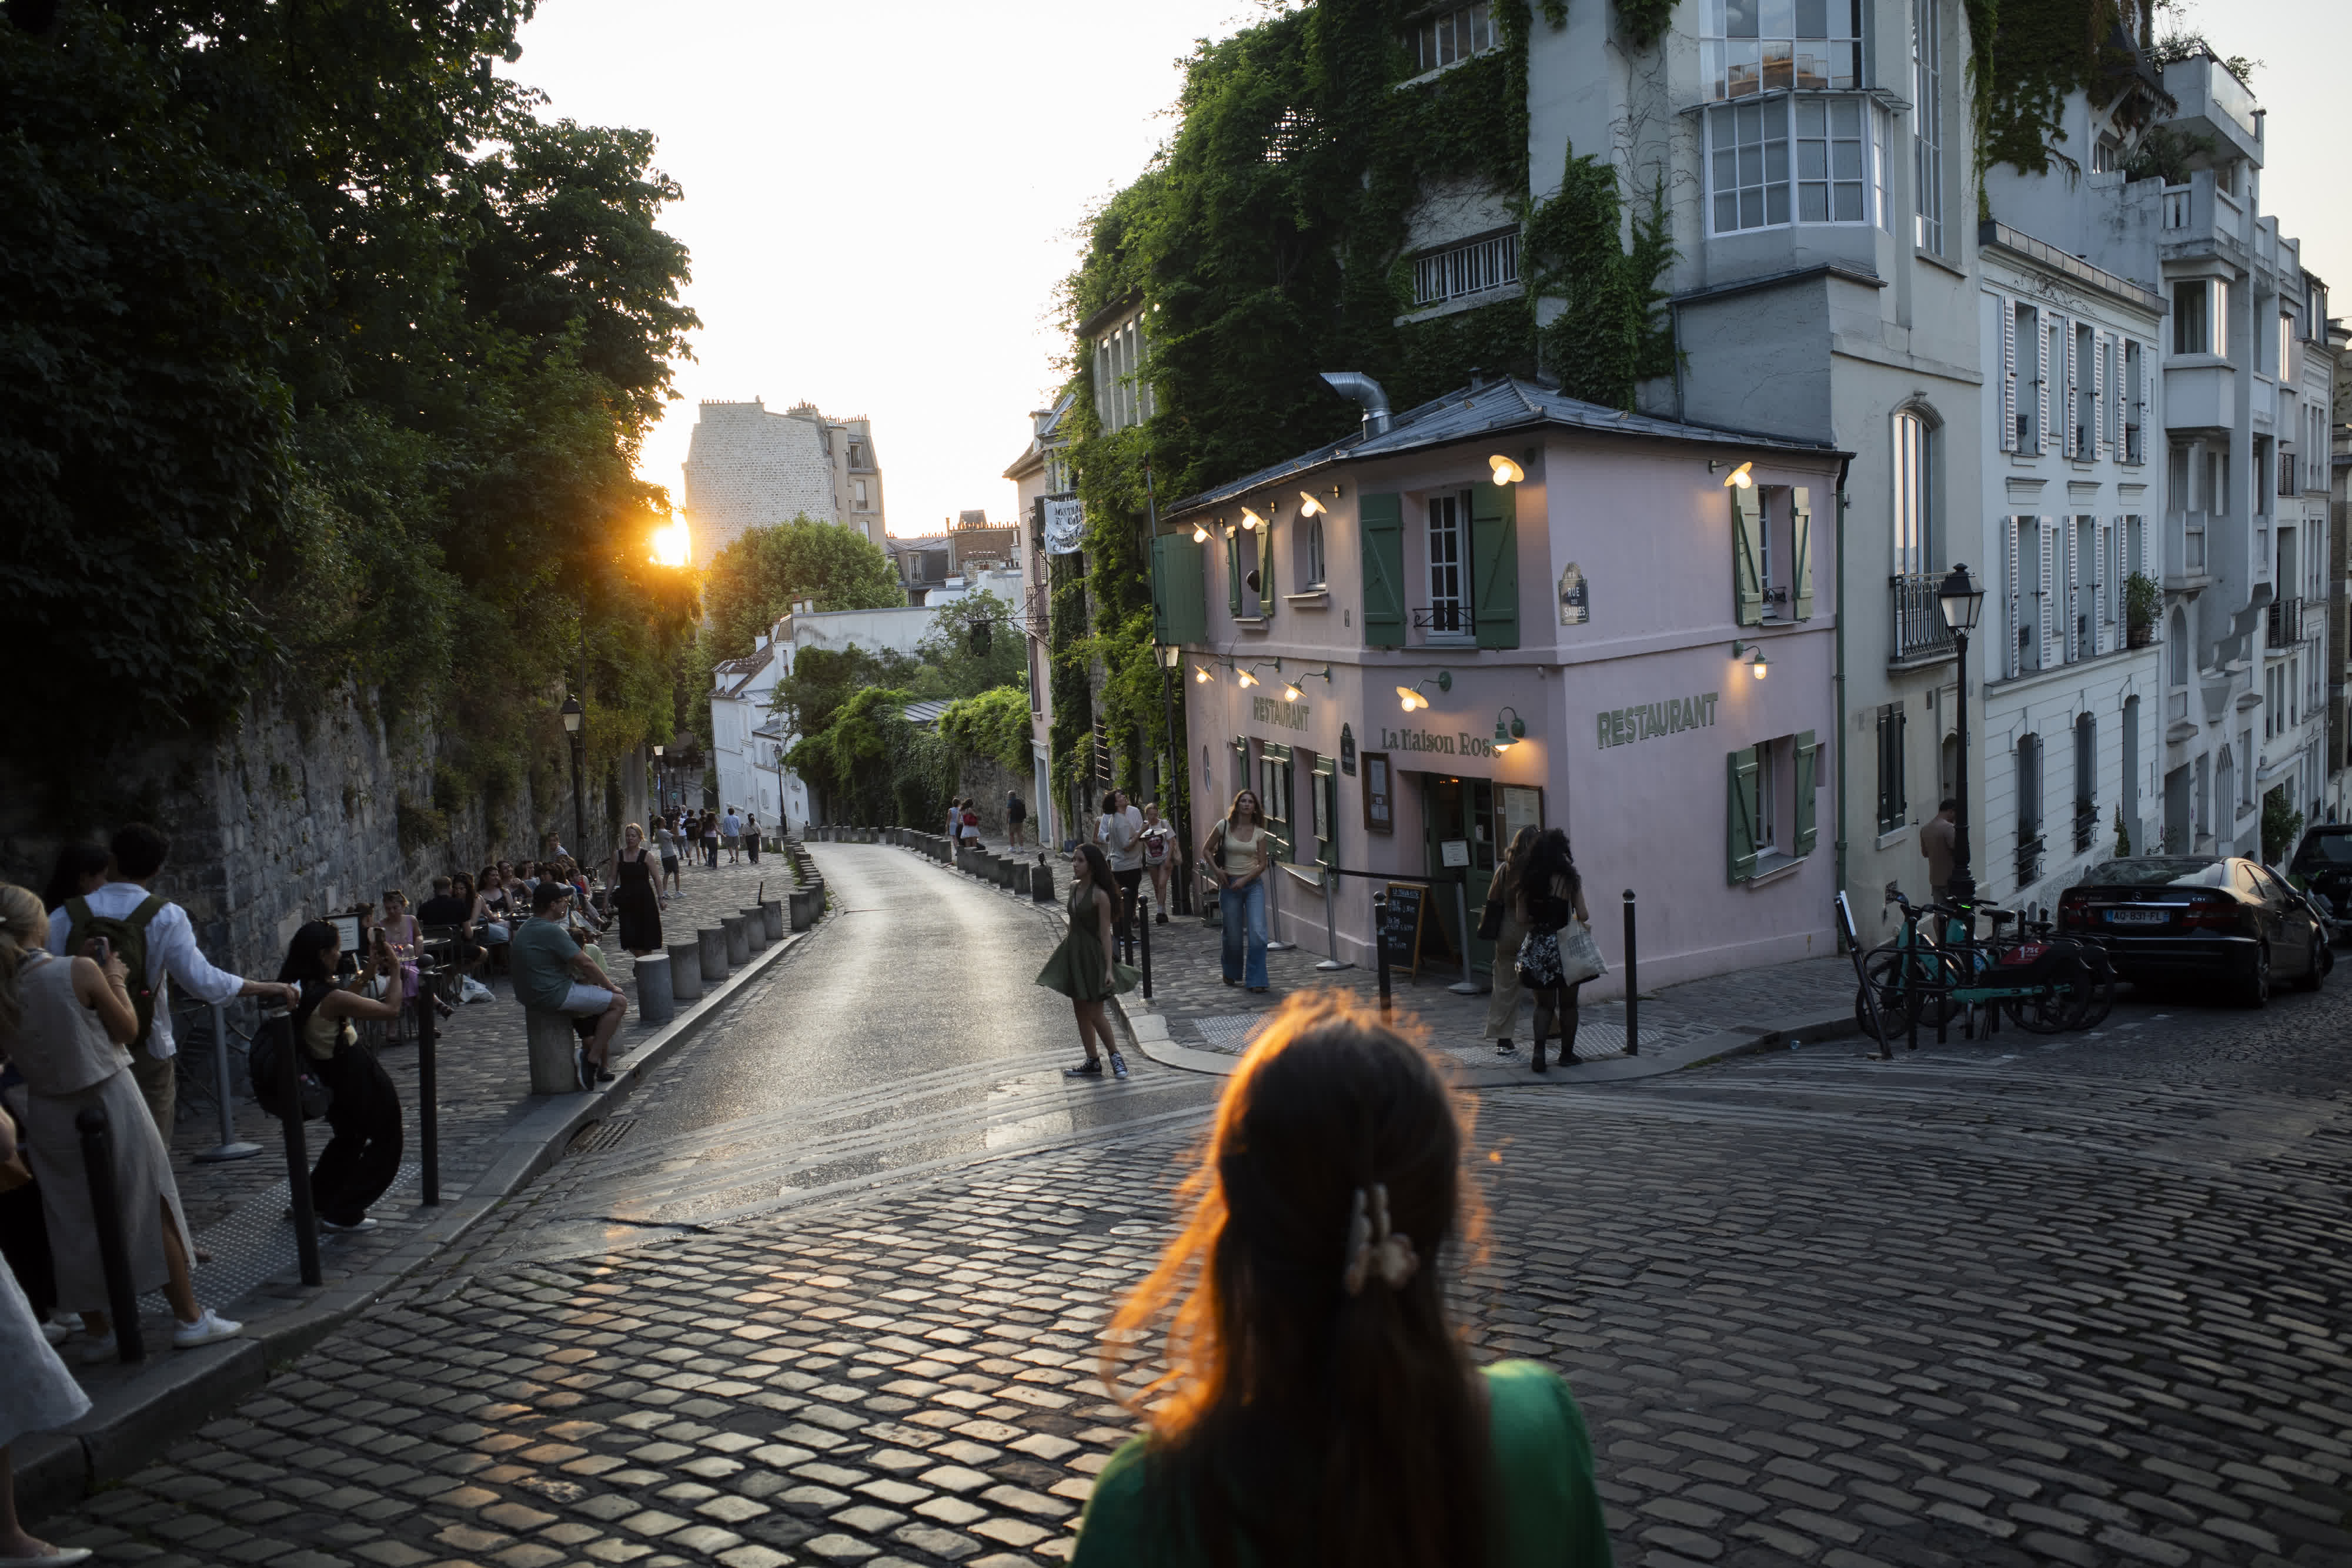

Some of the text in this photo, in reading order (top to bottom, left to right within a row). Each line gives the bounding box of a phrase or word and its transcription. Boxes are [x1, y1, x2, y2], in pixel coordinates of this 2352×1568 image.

[1567, 587, 1580, 597] RUE
[1564, 606, 1586, 617] SAULES
[1253, 696, 1309, 732] RESTAURANT
[1596, 692, 1718, 750] RESTAURANT
[1381, 728, 1399, 750] La
[1399, 728, 1455, 755] Maison
